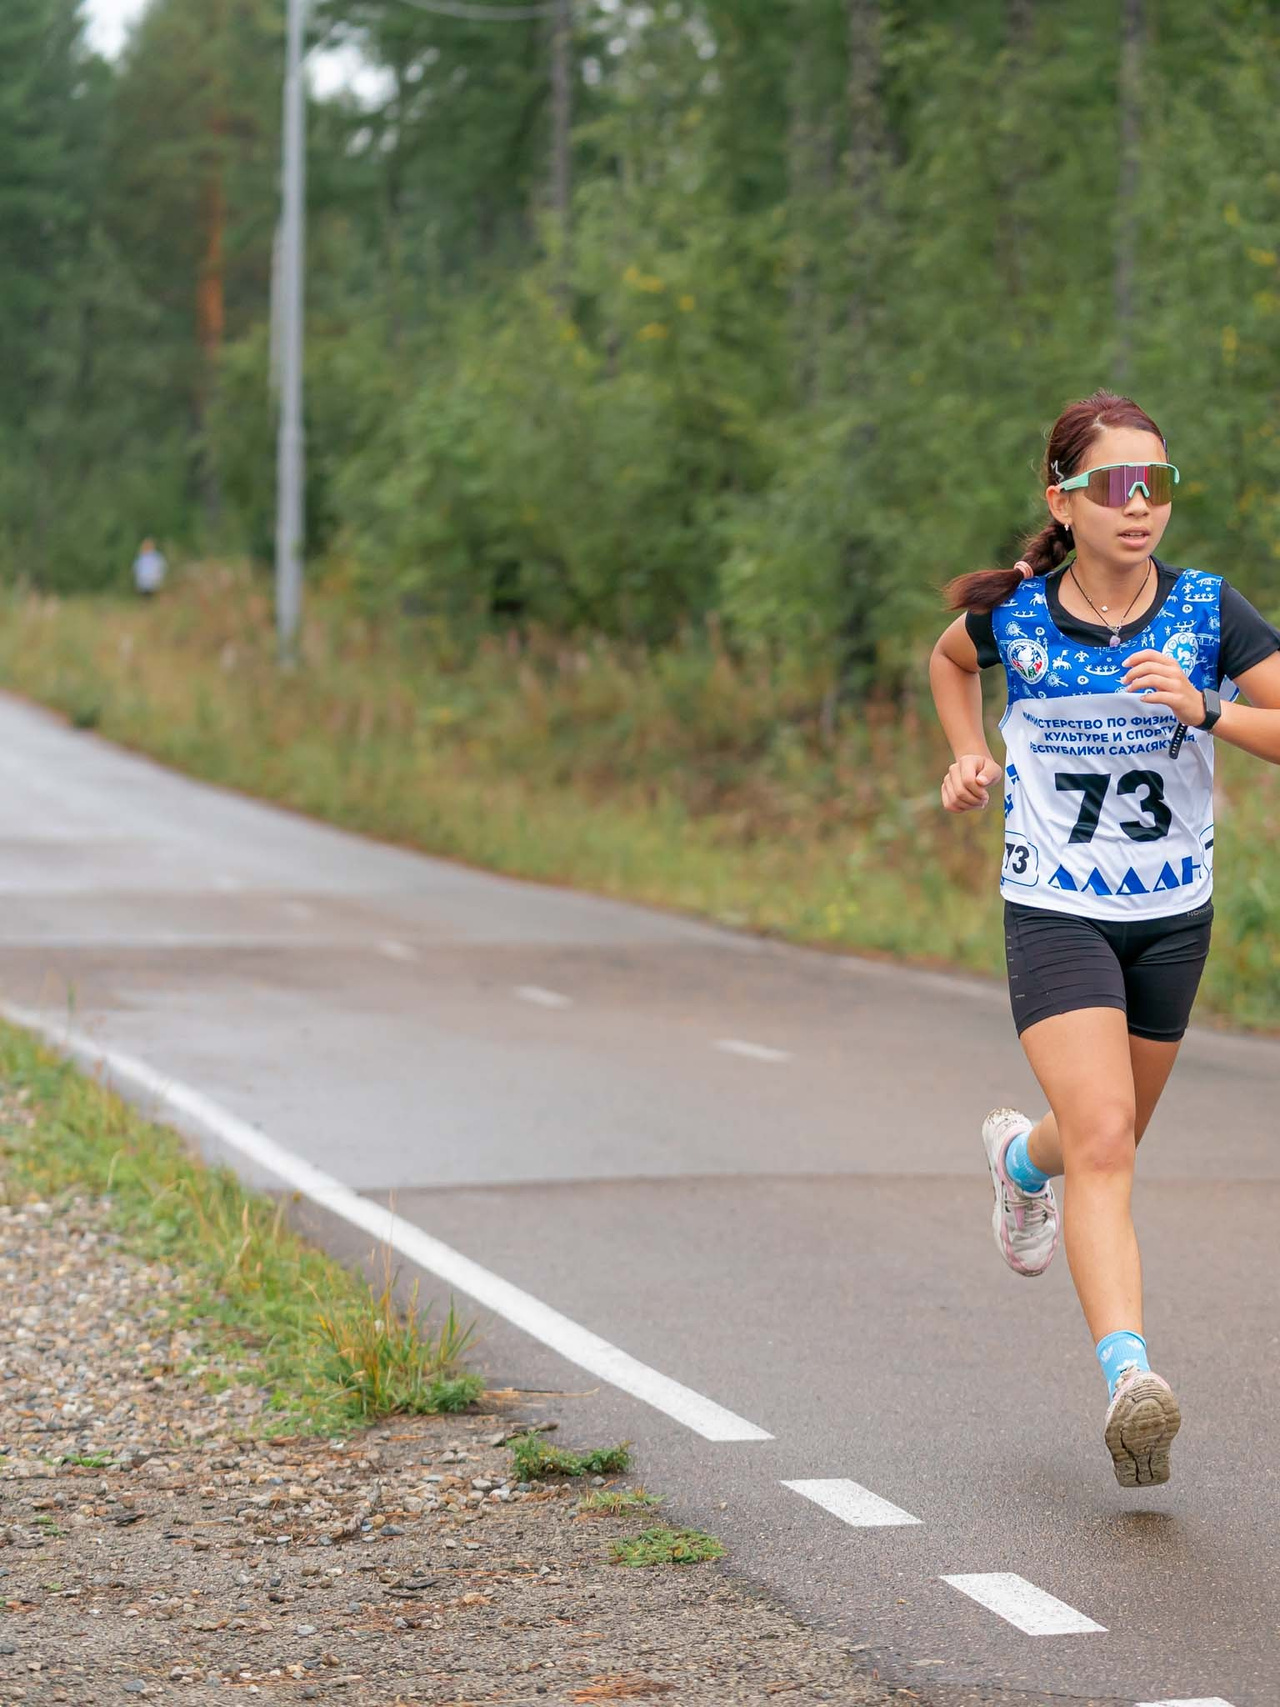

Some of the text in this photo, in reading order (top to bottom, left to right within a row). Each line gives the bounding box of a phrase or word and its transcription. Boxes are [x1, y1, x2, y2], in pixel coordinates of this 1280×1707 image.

[1107, 717, 1127, 728] ПО
[1044, 725, 1175, 743] КУЛЬТУРЕ И СПОРТУ
[1054, 769, 1173, 844] 73
